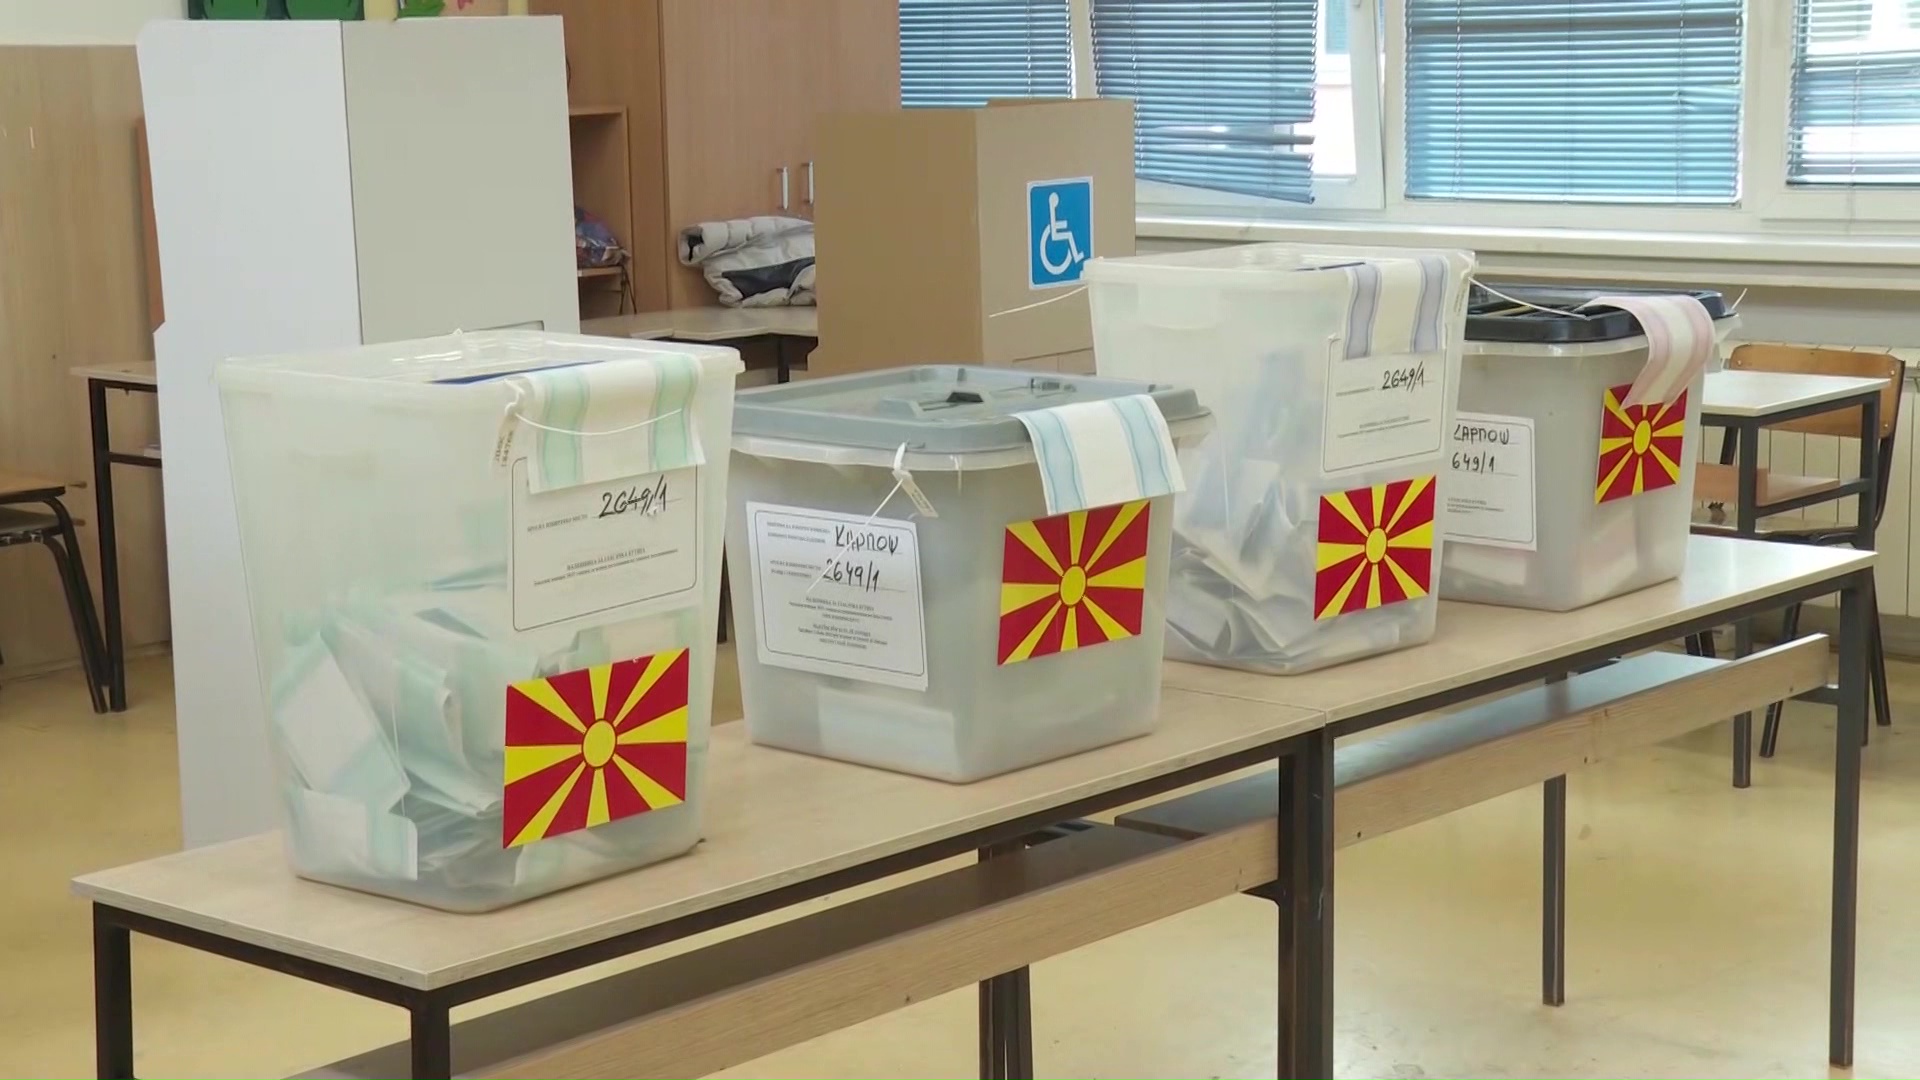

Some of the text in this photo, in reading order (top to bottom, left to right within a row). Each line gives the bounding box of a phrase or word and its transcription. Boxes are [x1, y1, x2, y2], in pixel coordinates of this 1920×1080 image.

[1381, 361, 1424, 393] 2649/1
[599, 474, 667, 519] 2649/1
[823, 558, 880, 592] 2649/1
